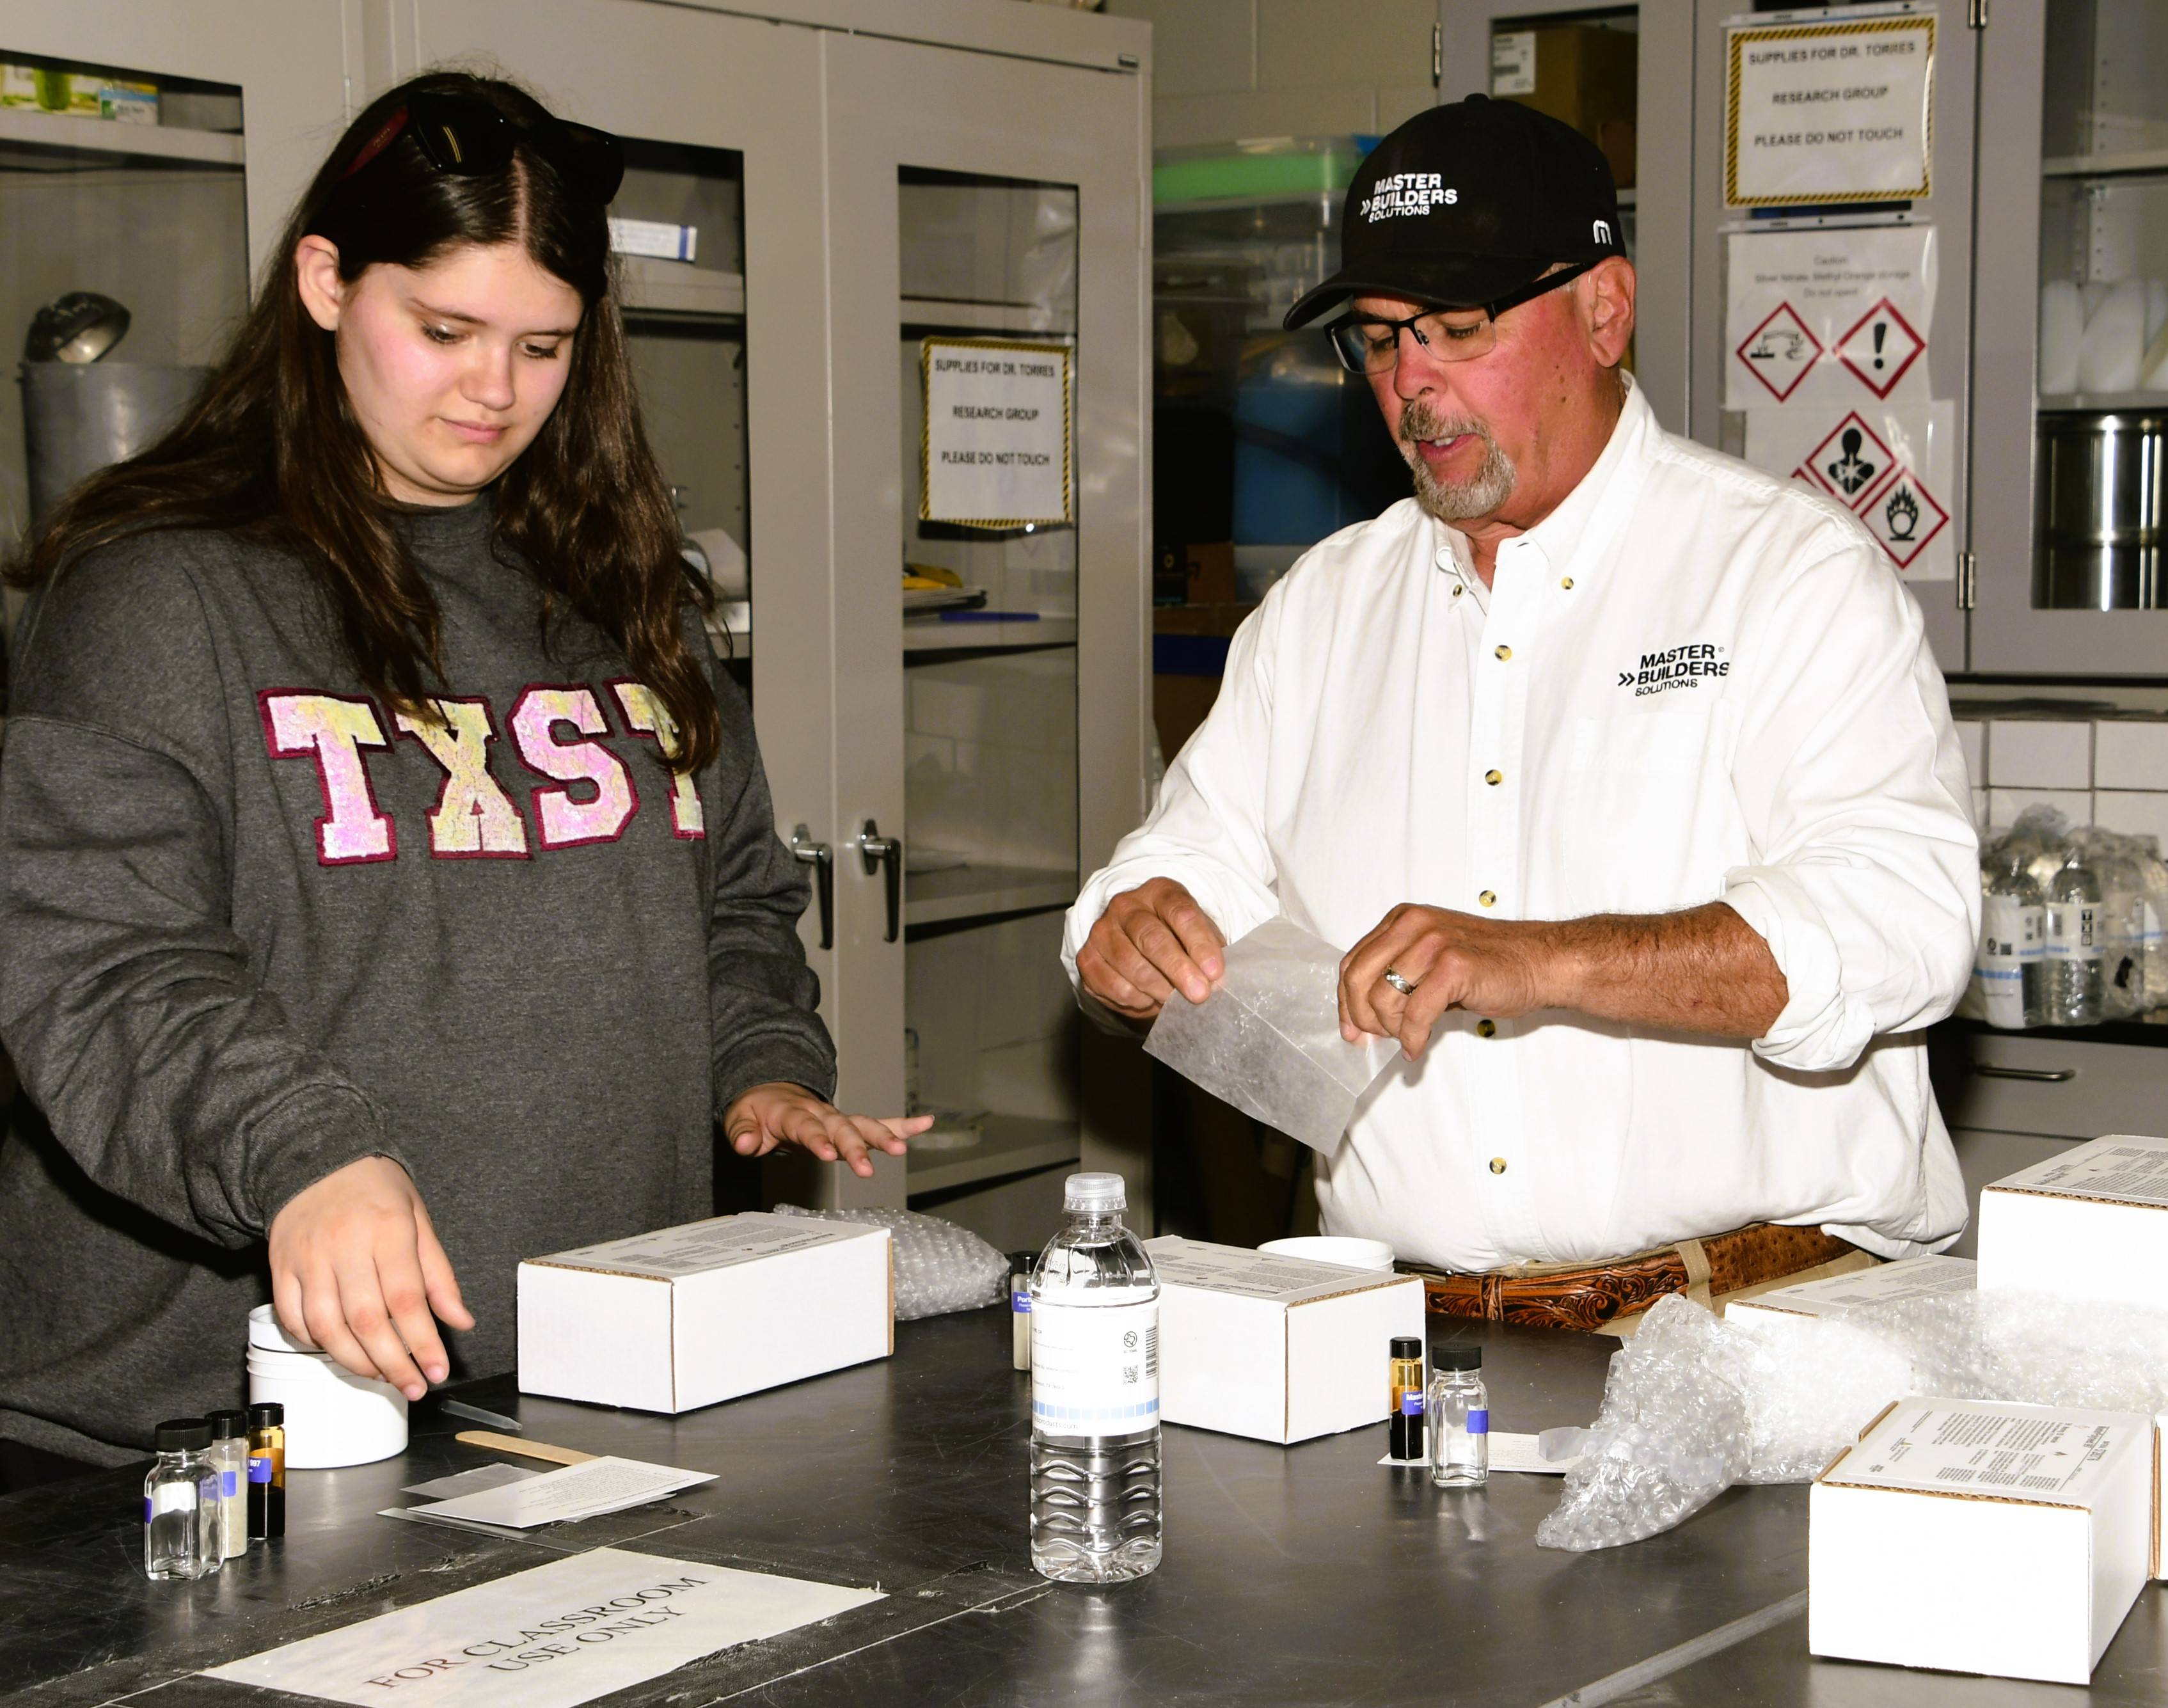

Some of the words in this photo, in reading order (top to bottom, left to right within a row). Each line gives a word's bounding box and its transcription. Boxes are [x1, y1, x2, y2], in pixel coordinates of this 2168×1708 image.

[1749, 49, 1807, 65] SUPPLIES
[1810, 45, 1837, 61] FOR
[1840, 45, 1860, 58] DR.
[1866, 41, 1915, 57] TORRES
[1771, 89, 1839, 106] RESEARCH
[1842, 86, 1888, 100] GROUP
[1754, 132, 1801, 147] PLEASE
[1805, 131, 1824, 145] DO
[1827, 130, 1854, 144] NOT
[1858, 128, 1904, 142] TOUCH
[1373, 173, 1442, 195] MASTER
[1371, 188, 1458, 212] BUILDERS
[1368, 205, 1430, 223] SOLUTIONS
[935, 359, 977, 374] SUPPLIES
[981, 361, 1001, 375] FOR
[1003, 363, 1017, 376] DR.
[1020, 363, 1055, 377] TORRES
[952, 405, 1003, 420] RESEARCH
[1005, 407, 1040, 421] GROUP
[941, 451, 976, 464] PLEASE
[978, 452, 993, 464] DO
[996, 452, 1015, 464] NOT
[1017, 453, 1050, 466] TOUCH
[1640, 644, 1715, 670] MASTER
[1636, 661, 1730, 685] BUILDERS
[1635, 678, 1698, 697] SOLUTIONS
[363, 1657, 470, 1689] FOR
[462, 1576, 711, 1657] CLASSROOM
[486, 1643, 580, 1672] USE
[575, 1604, 688, 1644] ONLY
